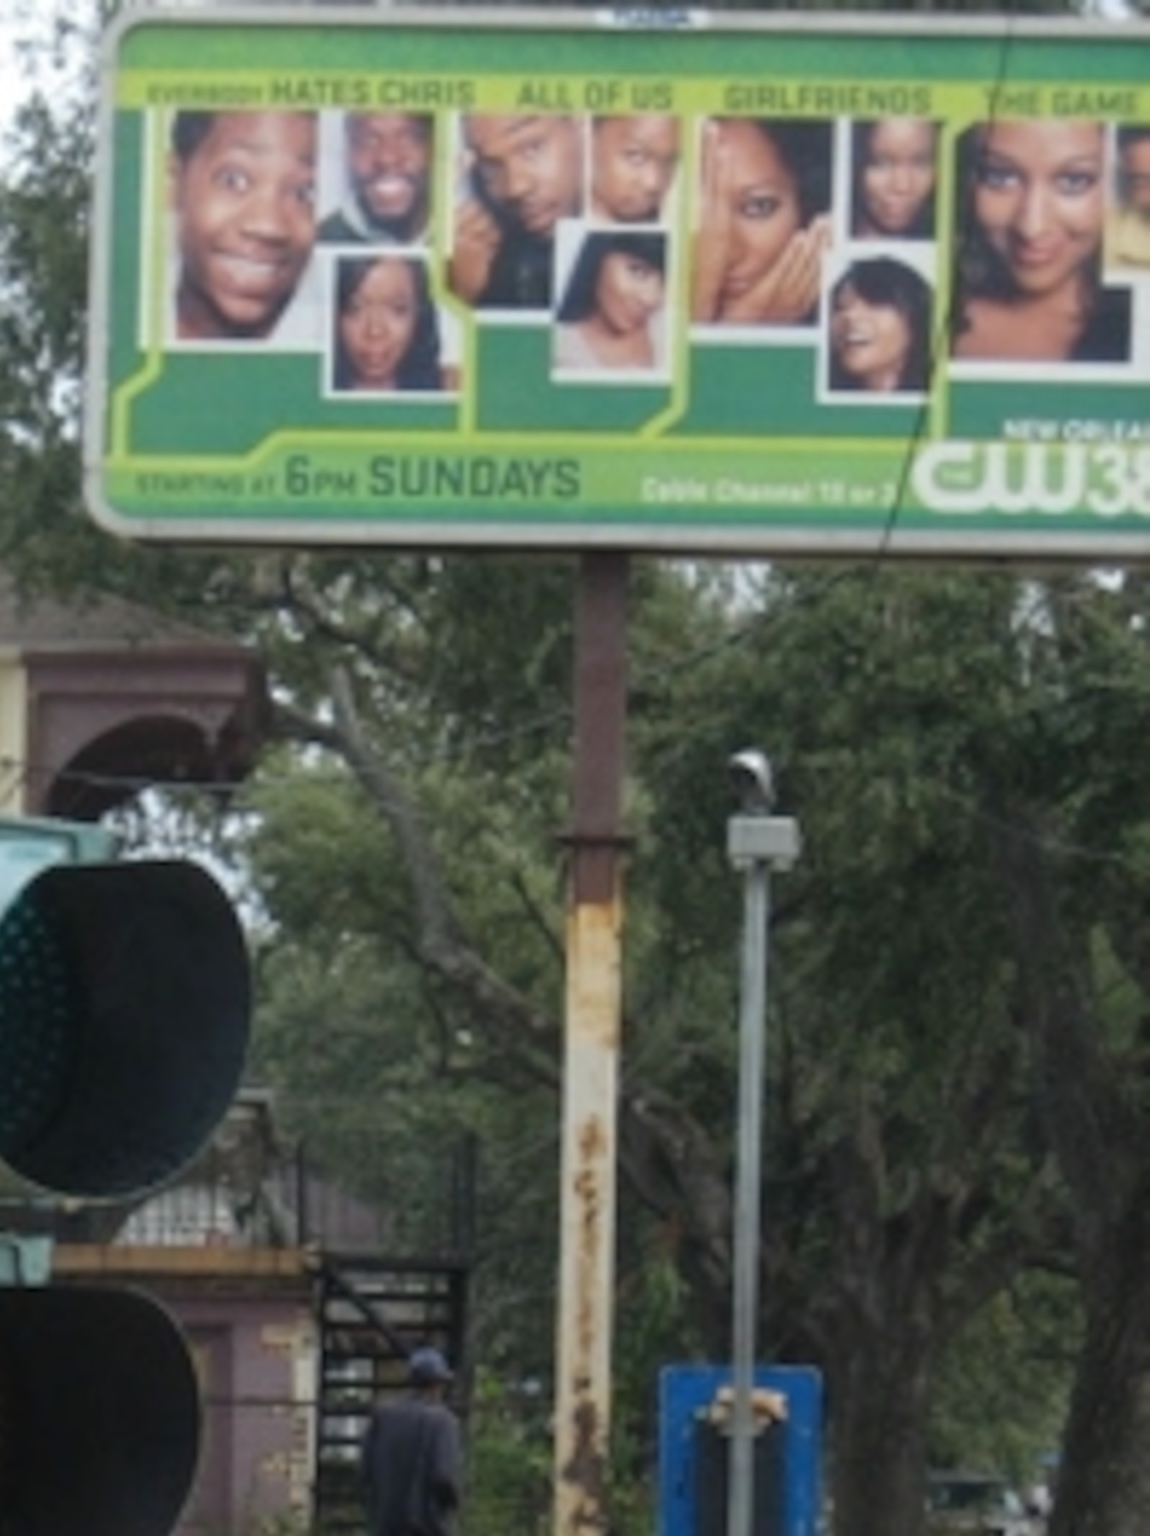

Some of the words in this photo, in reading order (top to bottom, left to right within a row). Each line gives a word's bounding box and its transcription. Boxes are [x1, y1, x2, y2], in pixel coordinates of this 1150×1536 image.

[270, 80, 371, 104] HATES
[378, 81, 476, 106] CHRIS
[516, 81, 574, 109] ALL
[584, 82, 623, 109] OF
[630, 83, 673, 109] US
[722, 84, 931, 112] GIRLFRIENDS
[983, 87, 1039, 115] THE
[1051, 88, 1139, 116] GAME
[1005, 419, 1057, 441] NEW
[369, 457, 582, 499] SUNDAYS
